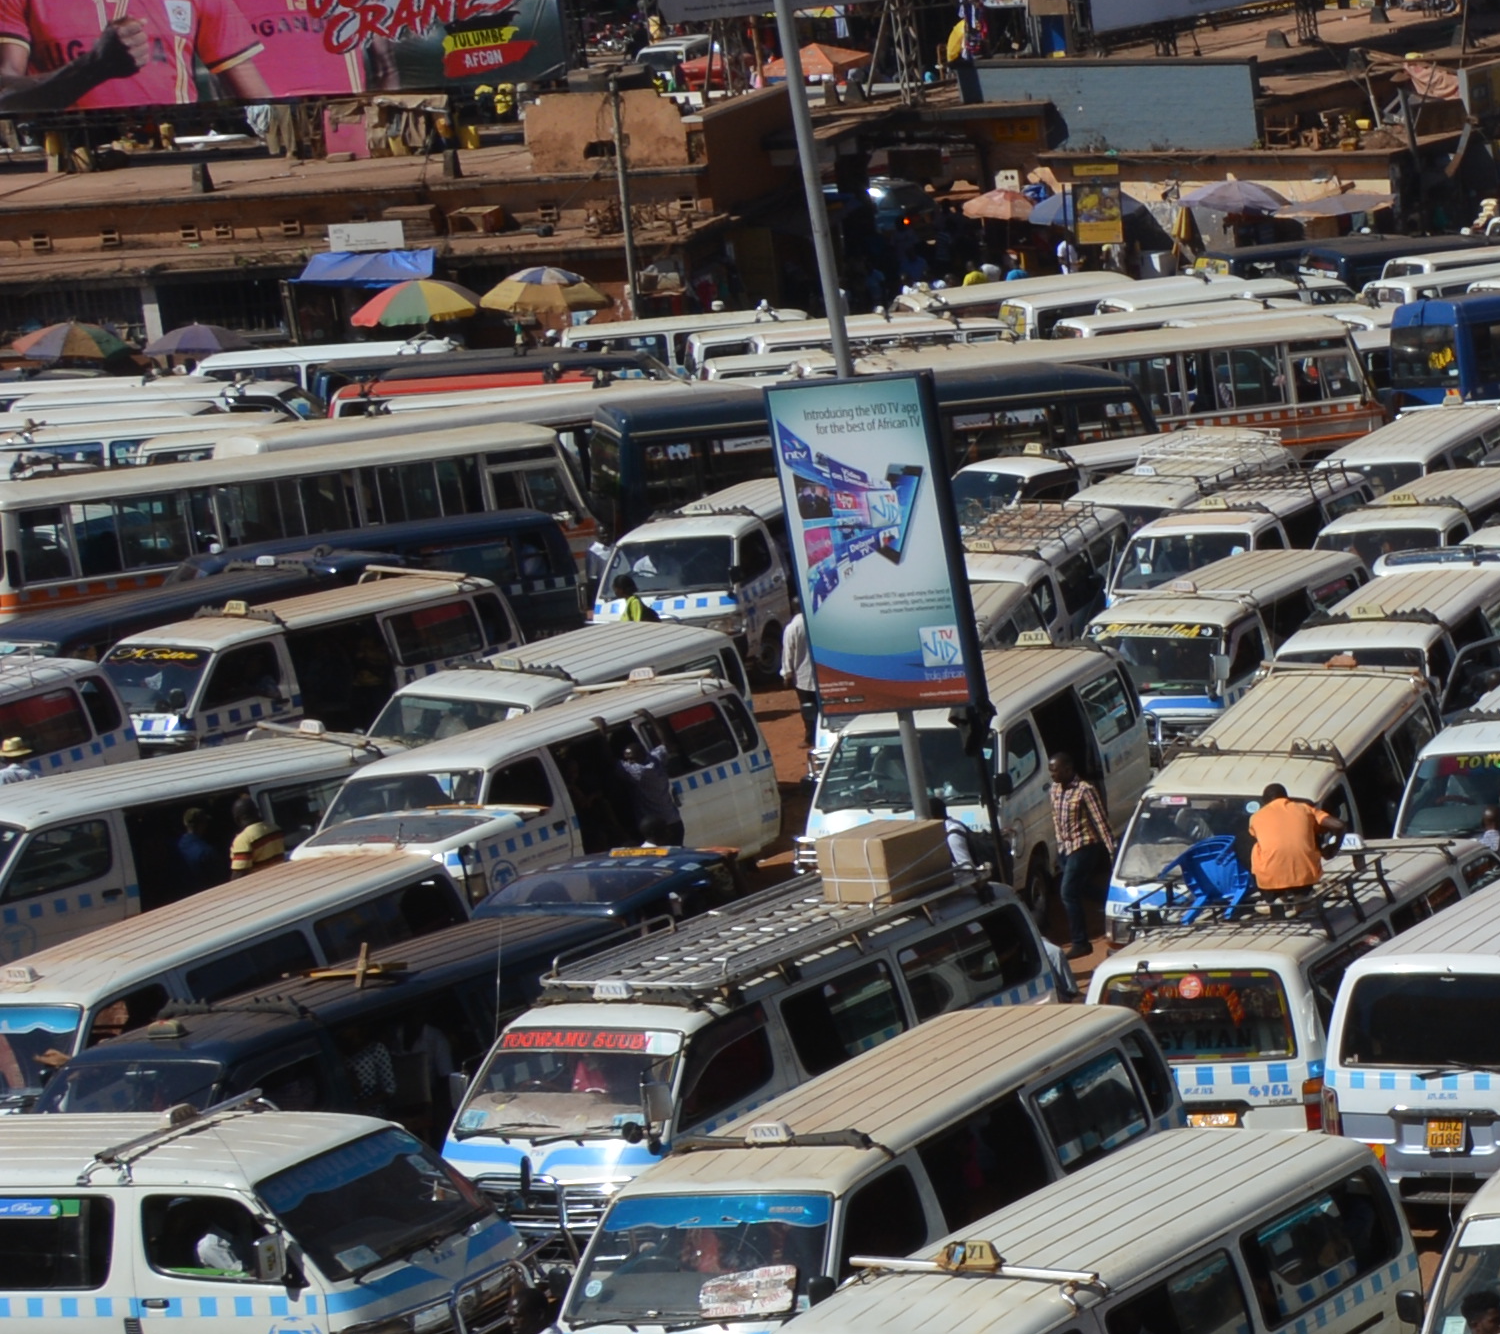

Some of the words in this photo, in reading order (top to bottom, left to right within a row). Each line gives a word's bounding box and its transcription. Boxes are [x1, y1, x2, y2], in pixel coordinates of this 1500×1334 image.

[451, 31, 507, 51] TULUMBE
[464, 50, 504, 69] AFCON
[803, 405, 854, 422] Introducing
[855, 405, 870, 418] the
[870, 403, 887, 415] VID
[888, 402, 899, 414] TV
[900, 403, 919, 416] app
[815, 421, 828, 435] for
[829, 421, 843, 434] the
[844, 420, 865, 433] best
[865, 419, 877, 431] of
[877, 417, 908, 431] African
[908, 415, 921, 428] TV
